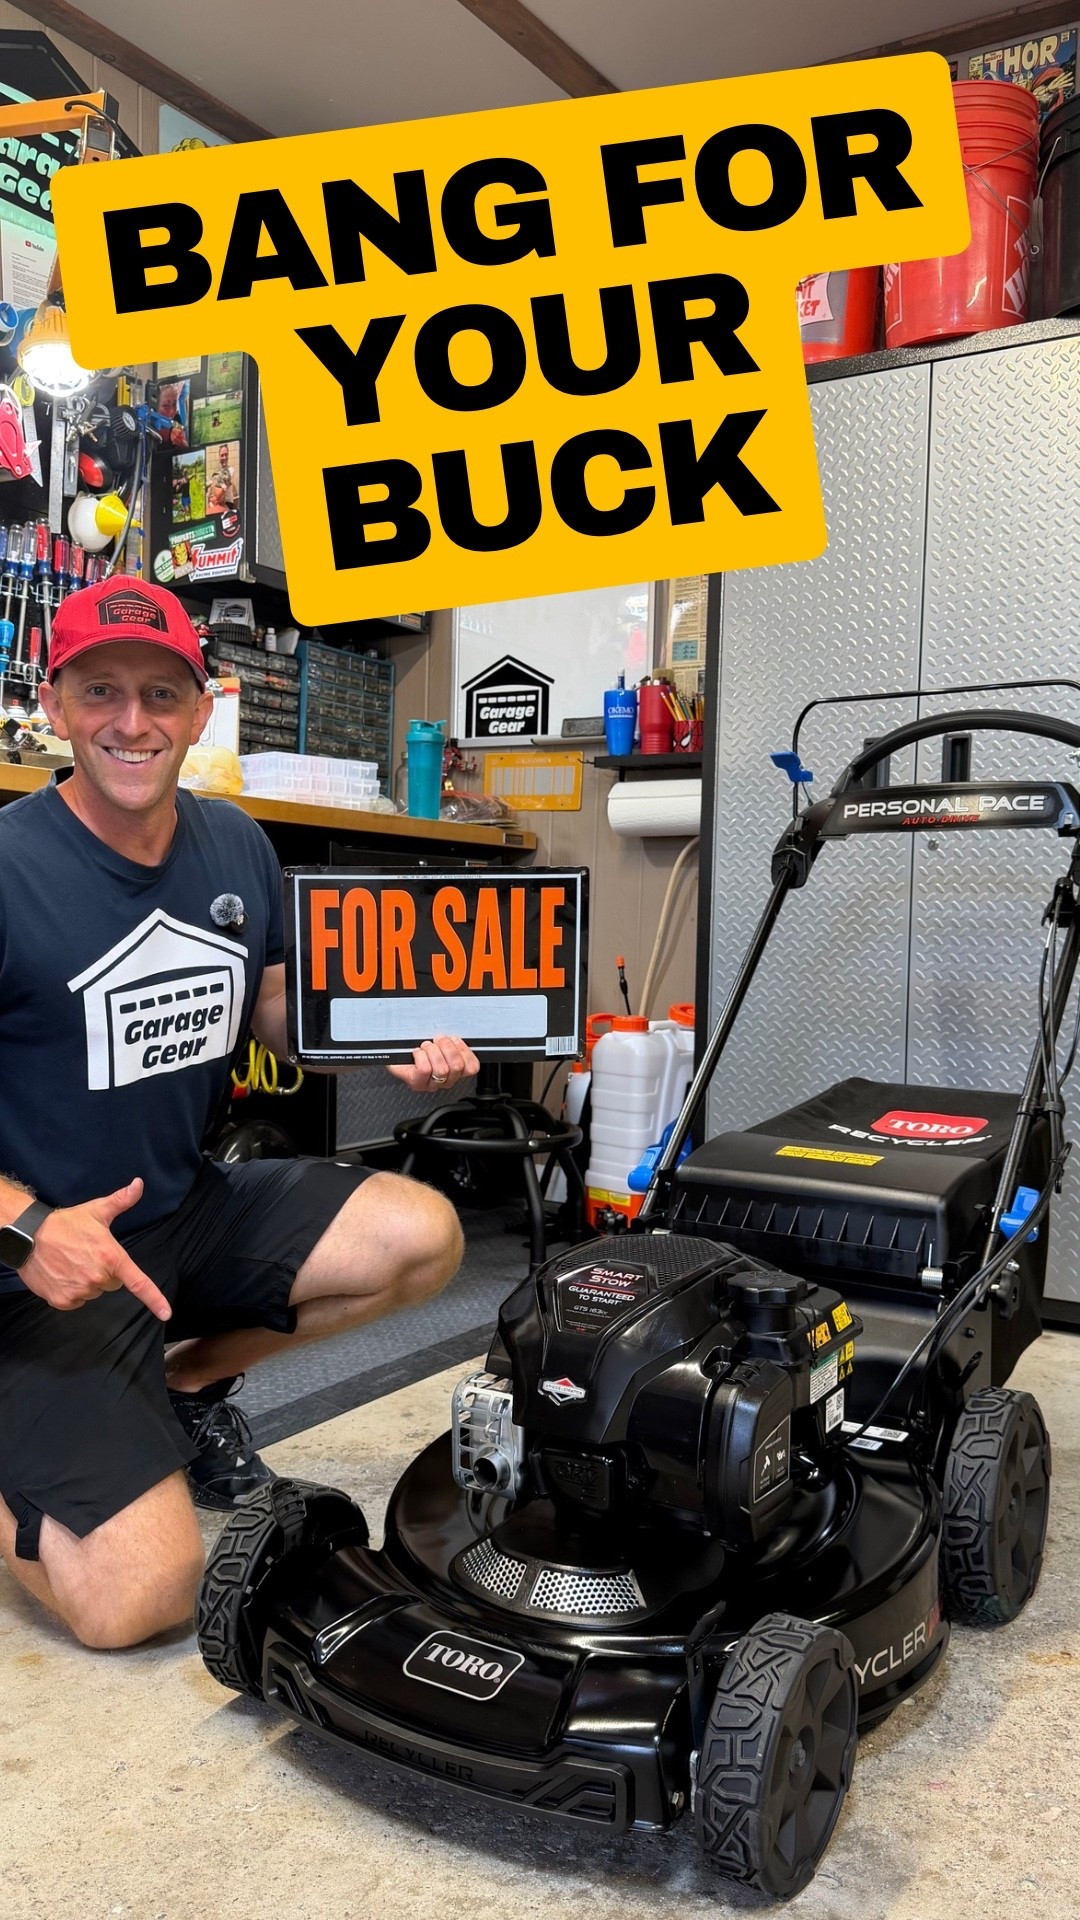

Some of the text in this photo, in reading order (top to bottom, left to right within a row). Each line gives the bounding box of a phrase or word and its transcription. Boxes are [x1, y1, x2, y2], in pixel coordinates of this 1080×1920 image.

[985, 35, 1058, 77] THOR
[113, 608, 157, 619] Garage
[121, 614, 151, 623] Gear
[480, 706, 535, 719] Garage
[607, 706, 635, 714] OKEMO
[488, 721, 525, 734] Gear
[843, 795, 1045, 819] PERSONAL PACE
[310, 886, 566, 992] FOR SALE
[124, 1004, 224, 1045] Garage
[142, 1036, 208, 1069] Gear
[828, 1124, 987, 1146] RECYCLER
[889, 1119, 974, 1135] TORO
[589, 1275, 632, 1288] STOW
[590, 1267, 644, 1281] SMART
[568, 1285, 635, 1301] GUARANTEED
[592, 1296, 622, 1306] START
[854, 1621, 926, 1685] YCLER
[364, 1730, 473, 1781] RECYCLER
